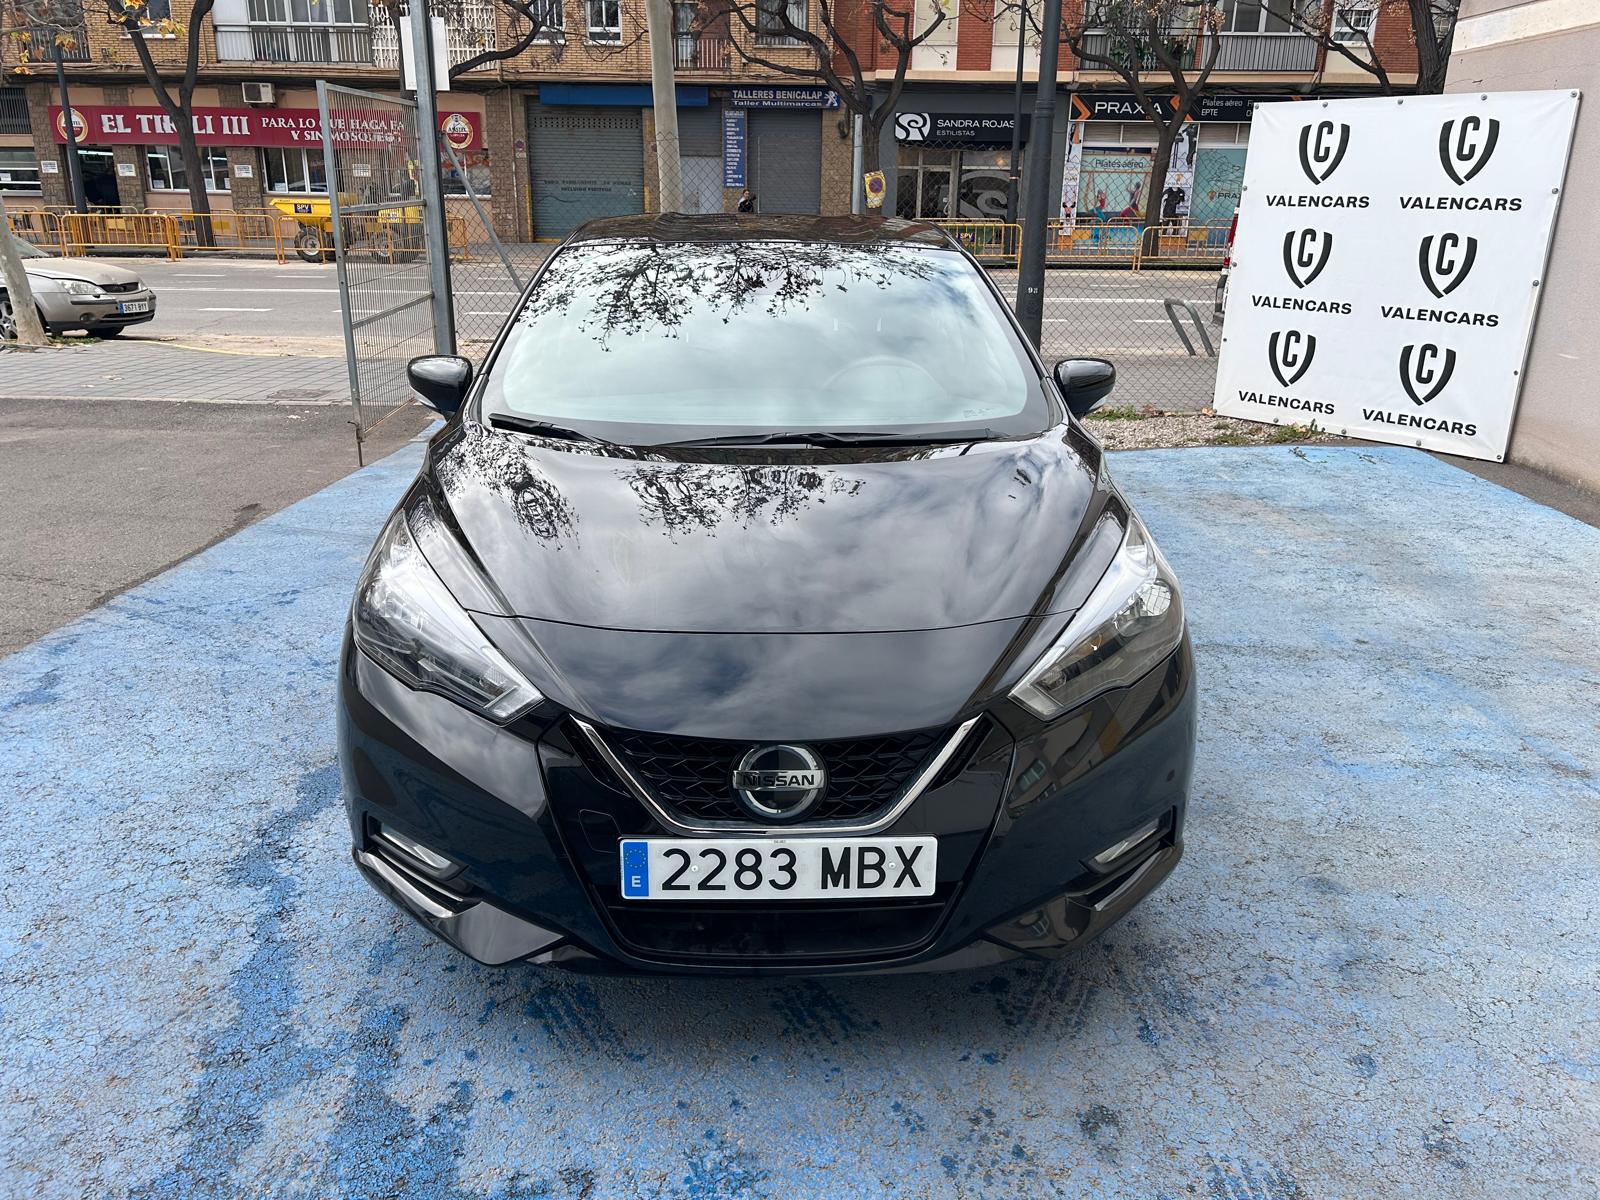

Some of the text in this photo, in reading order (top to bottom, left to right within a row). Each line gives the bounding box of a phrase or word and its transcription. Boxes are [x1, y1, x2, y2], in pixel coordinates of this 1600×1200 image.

[732, 90, 823, 100] TALLERES BENICALAP
[1095, 101, 1163, 115] PRAXA
[1202, 98, 1224, 107] Pilates
[1201, 108, 1218, 116] EPTE
[100, 114, 251, 135] EL TIRLI III
[261, 117, 296, 128] PARA
[298, 118, 316, 128] LO
[318, 118, 345, 129] UE
[937, 119, 1015, 129] SANDRA ROJAS
[291, 130, 301, 140] Y
[304, 130, 324, 141] SIN
[1095, 159, 1121, 168] Pilates
[1266, 194, 1370, 208] VALENCARS
[1399, 196, 1522, 211] VALENCARS
[1252, 294, 1352, 315] VALENCARS
[1381, 305, 1500, 328] VALENCARS
[1238, 390, 1335, 415] VALENCARS
[1362, 408, 1477, 436] VALENCARS
[742, 773, 815, 788] NISSAN
[661, 845, 924, 892] 2283 MBX
[631, 875, 641, 888] E
